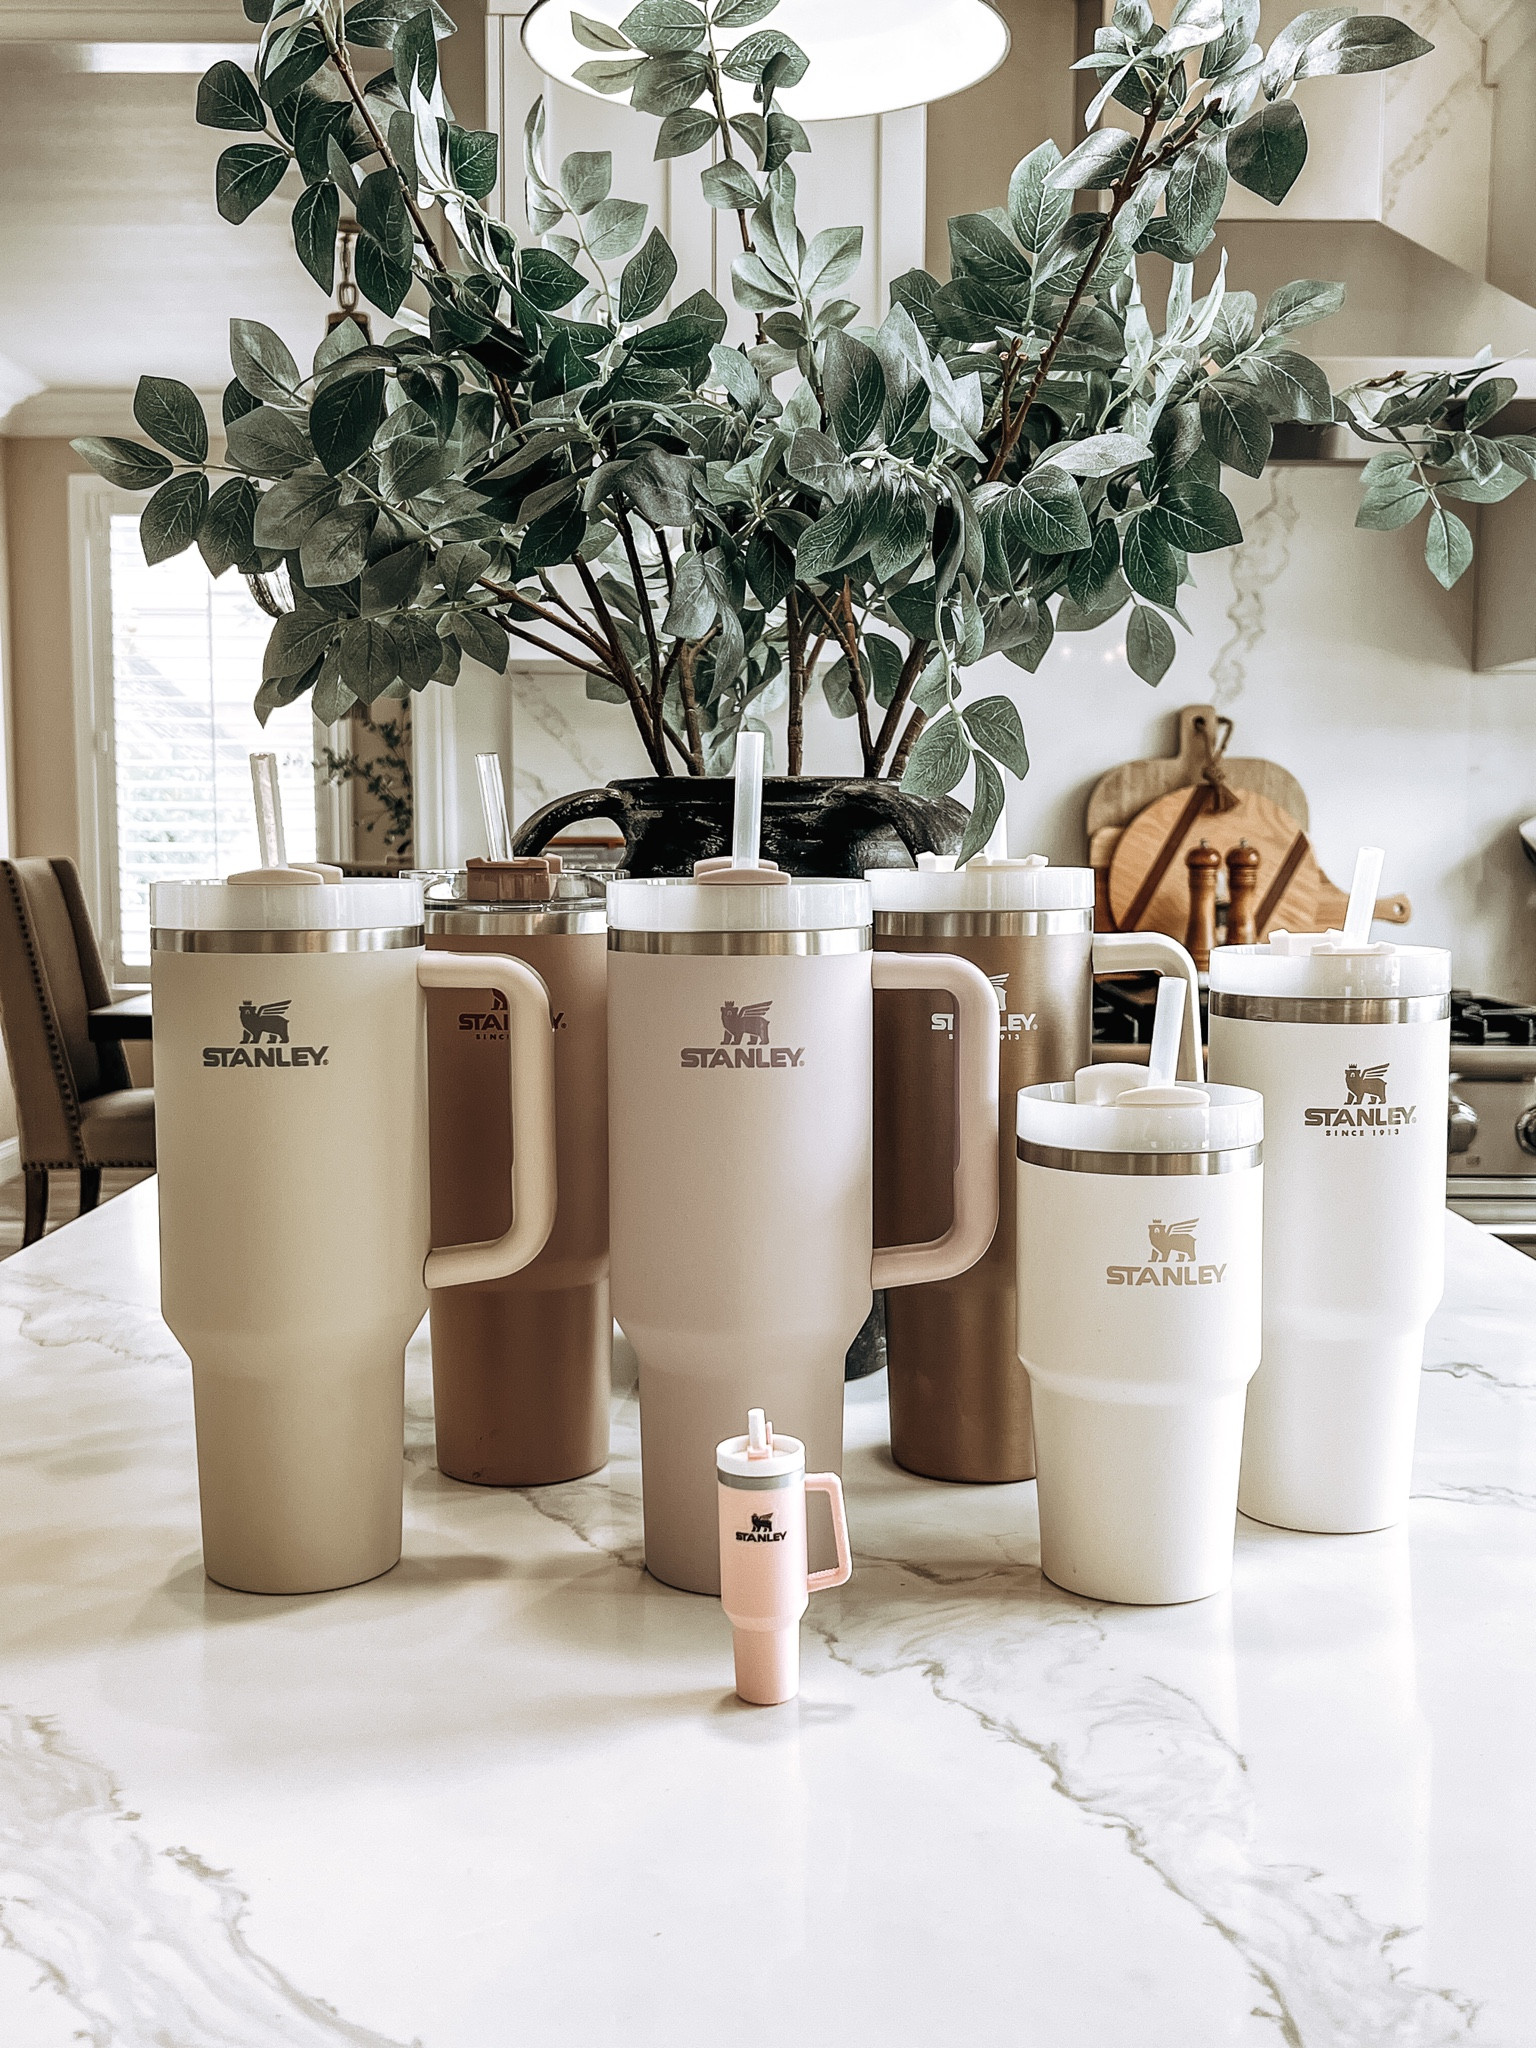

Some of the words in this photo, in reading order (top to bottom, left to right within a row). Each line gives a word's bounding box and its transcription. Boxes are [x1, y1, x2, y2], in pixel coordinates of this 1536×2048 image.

[459, 1013, 564, 1030] STAY
[931, 1013, 1036, 1031] STEY
[203, 1046, 328, 1067] STANLEY
[681, 1047, 805, 1068] STANLEY
[1304, 1105, 1416, 1126] STANLEY
[1325, 1129, 1365, 1137] SINCE
[1372, 1128, 1399, 1137] 1913
[1106, 1263, 1227, 1286] STANLEY
[736, 1531, 787, 1542] STANLEY
